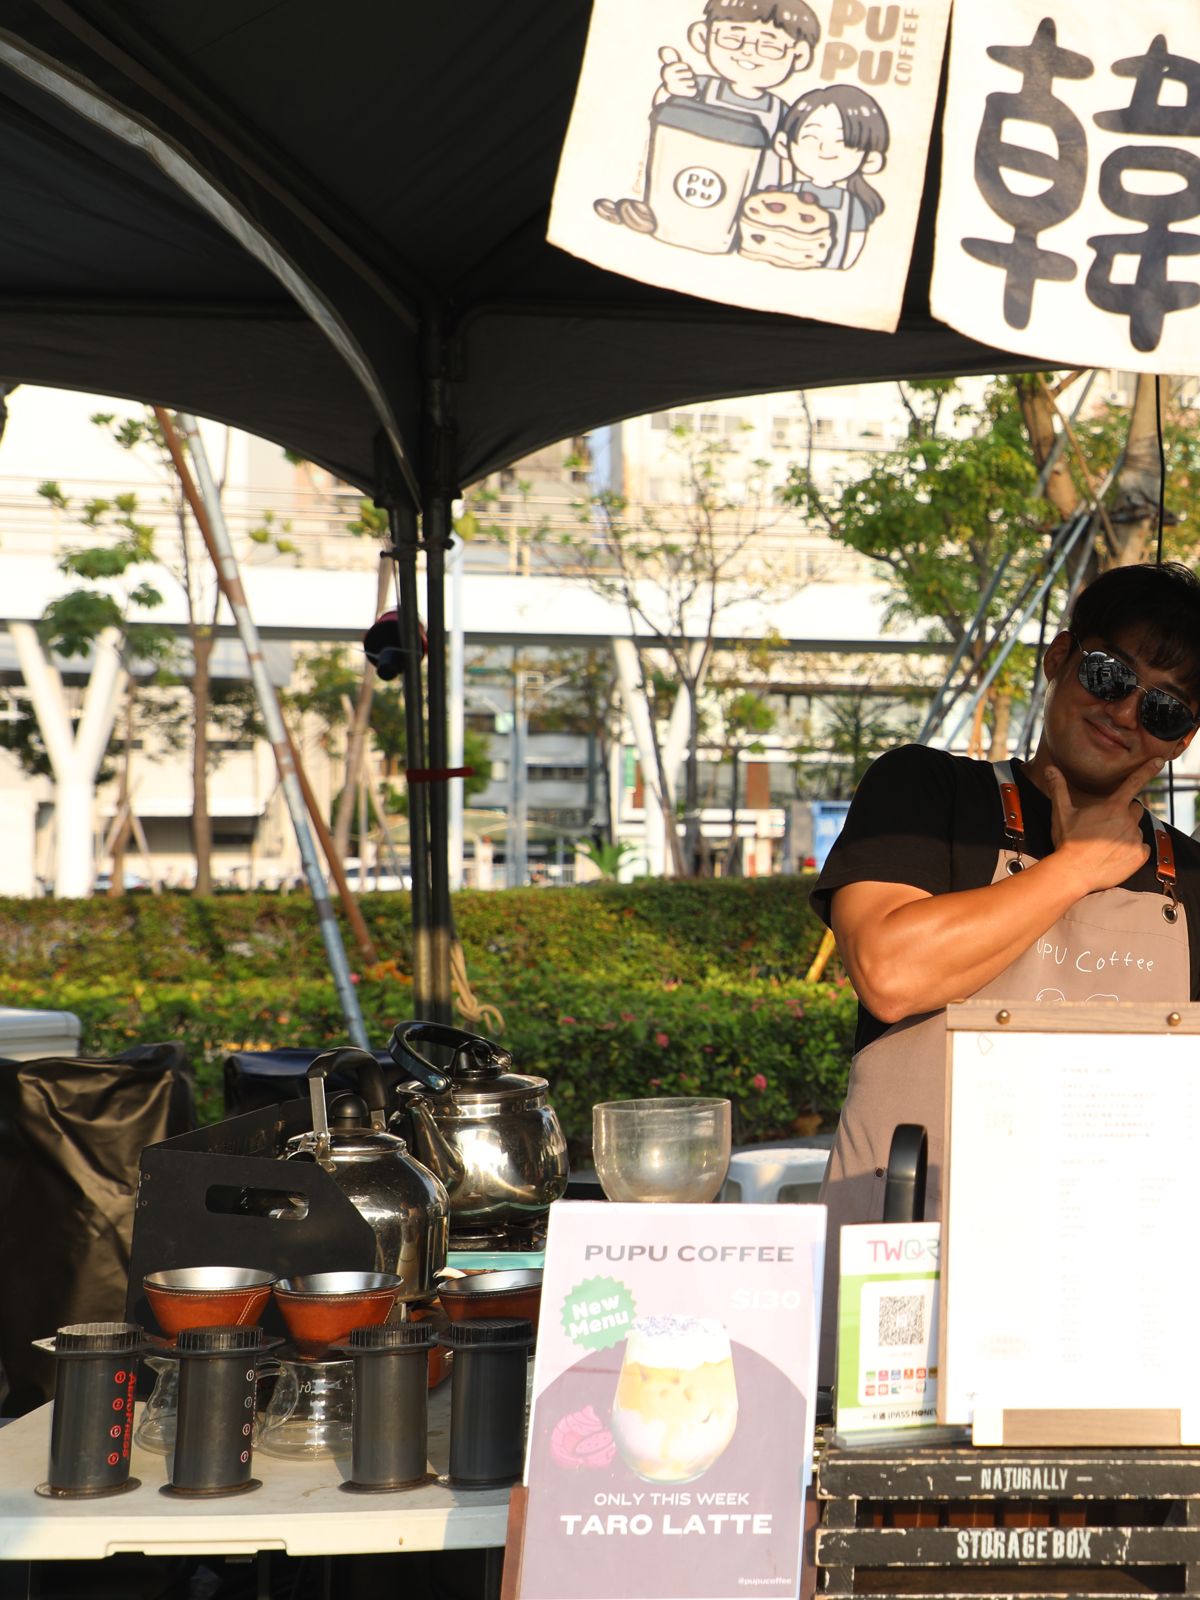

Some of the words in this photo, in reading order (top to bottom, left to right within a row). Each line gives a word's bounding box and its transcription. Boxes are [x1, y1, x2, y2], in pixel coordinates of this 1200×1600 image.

[828, 0, 900, 42] PU
[894, 8, 919, 86] COFFEE
[820, 42, 893, 86] PU
[1037, 939, 1067, 965] UPU
[585, 1245, 668, 1262] PUPU
[677, 1245, 795, 1262] COFFEE
[572, 1295, 619, 1320] New
[569, 1310, 629, 1339] Menu
[981, 1467, 1068, 1492] NATURALLY
[594, 1492, 645, 1506] ONLY
[650, 1492, 691, 1506] THIS
[697, 1492, 750, 1505] WEEK
[560, 1514, 653, 1535] TARO
[662, 1514, 773, 1535] LATTE
[957, 1530, 1048, 1559] STORAGE
[1052, 1530, 1091, 1559] BOX
